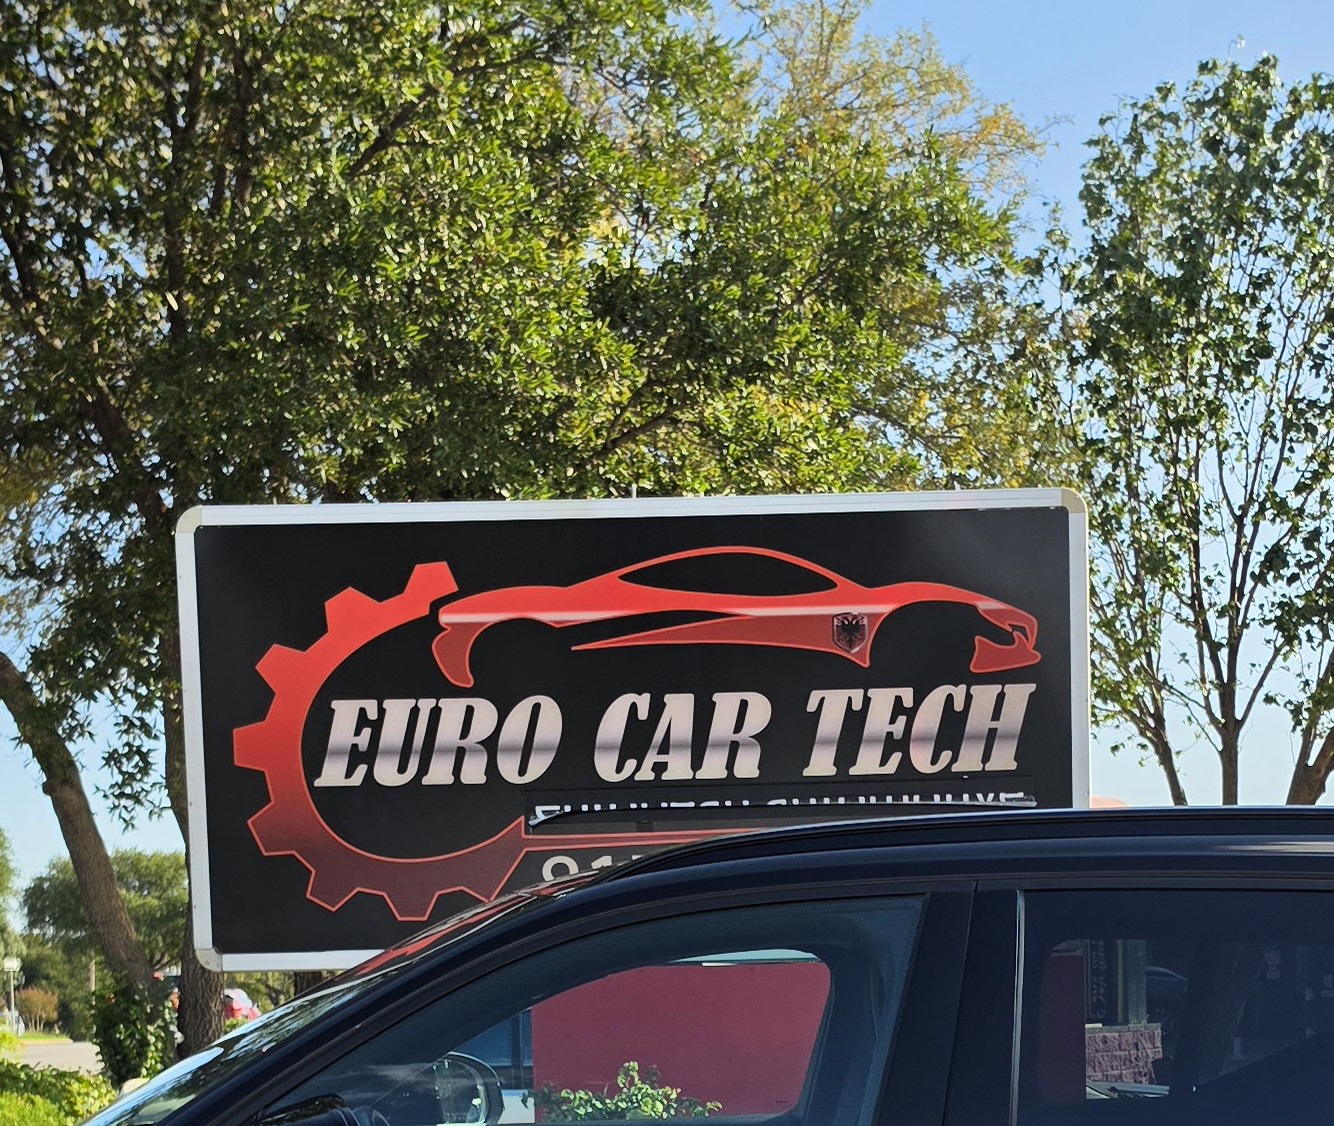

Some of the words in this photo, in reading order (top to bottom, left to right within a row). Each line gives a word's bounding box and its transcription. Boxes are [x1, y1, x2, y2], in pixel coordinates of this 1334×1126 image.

[314, 695, 563, 787] EURO
[594, 691, 772, 782] CAR
[803, 683, 1037, 776] TECH
